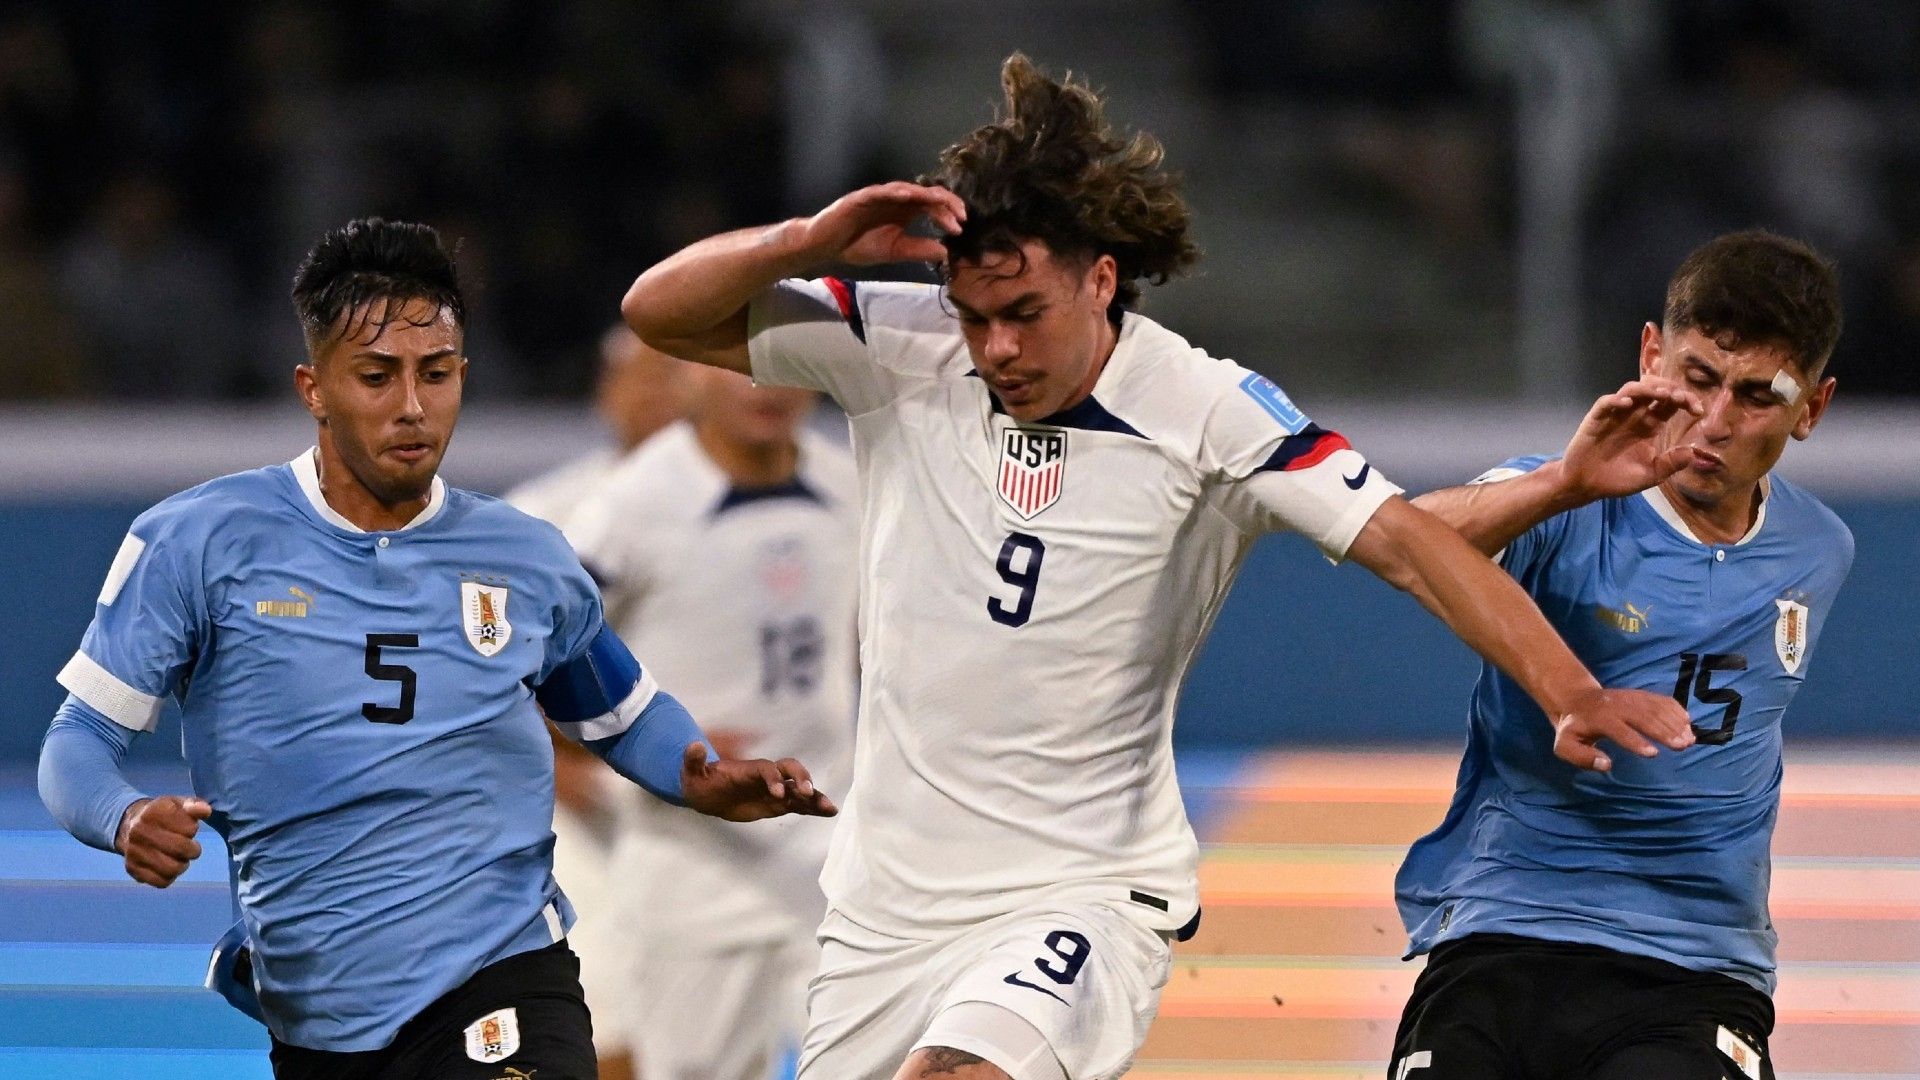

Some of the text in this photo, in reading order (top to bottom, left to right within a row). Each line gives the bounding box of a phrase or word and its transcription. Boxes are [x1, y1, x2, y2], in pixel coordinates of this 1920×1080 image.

[1007, 434, 1062, 468] USA
[986, 531, 1046, 628] 9
[1596, 606, 1640, 633] MA
[361, 633, 419, 725] 5
[1672, 653, 1748, 746] 15
[1034, 930, 1092, 985] 9
